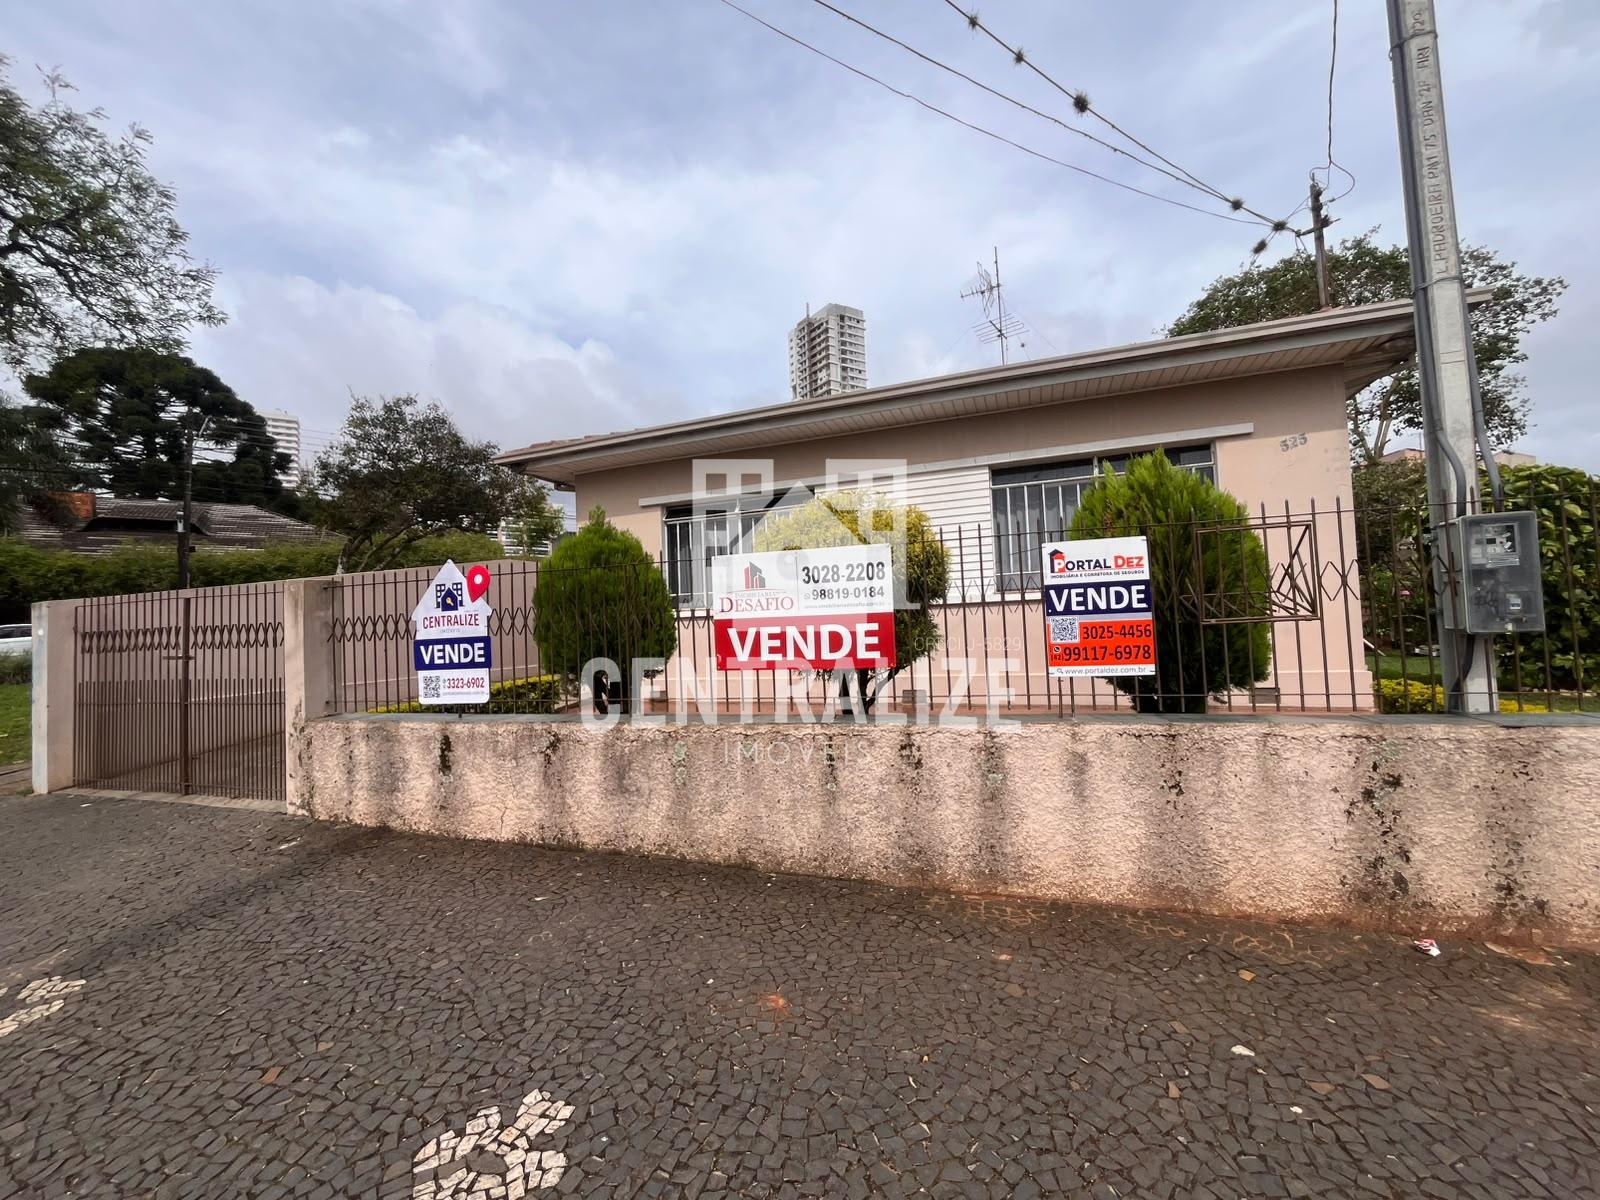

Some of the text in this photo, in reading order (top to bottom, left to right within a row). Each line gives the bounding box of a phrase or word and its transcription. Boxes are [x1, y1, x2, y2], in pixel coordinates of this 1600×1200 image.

[1052, 554, 1144, 573] PORTAL DEZ
[802, 561, 886, 585] 3028-2208
[811, 586, 885, 600] 98819-0184
[1049, 584, 1148, 612] VENDE
[719, 596, 794, 613] DESAFIO
[422, 613, 480, 629] CENTRALIZE
[1083, 624, 1152, 640] 3025-4456
[727, 622, 881, 662] VENDE
[420, 643, 485, 665] VENDE
[1063, 645, 1151, 662] 99117-6978
[1065, 666, 1146, 674] www.portaldez.com.br
[447, 677, 486, 690] 3323-6902
